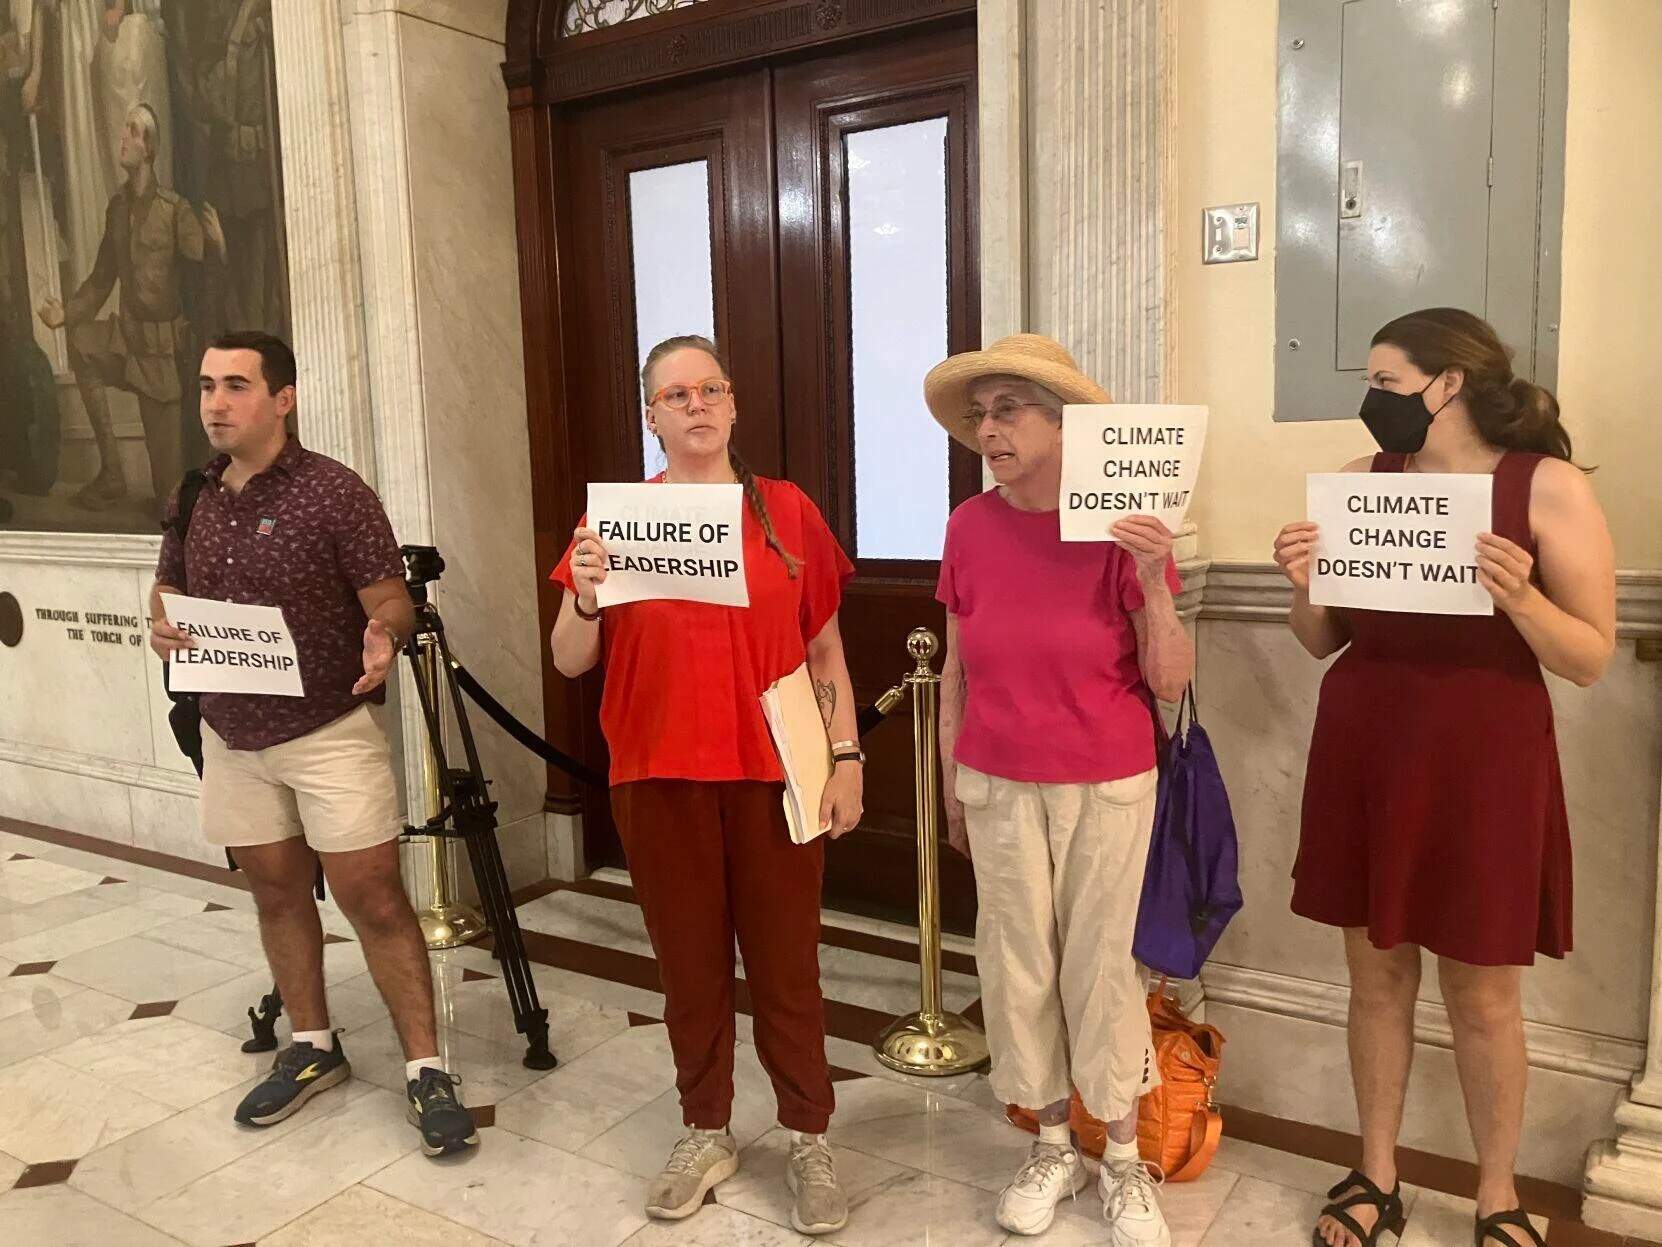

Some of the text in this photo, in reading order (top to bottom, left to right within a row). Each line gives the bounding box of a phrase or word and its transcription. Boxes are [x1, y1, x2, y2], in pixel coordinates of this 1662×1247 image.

[1102, 427, 1185, 445] CLIMATE
[1103, 459, 1181, 478] CHANGE
[1069, 490, 1191, 510] DOESN'T WAIT
[1347, 495, 1449, 516] CLIMATE
[599, 520, 730, 544] FAILURE OF
[1349, 527, 1447, 549] CHANGE
[604, 554, 739, 578] EADERSHIP
[1317, 558, 1479, 584] DOESN'T WAIT
[35, 608, 79, 623] THROUGH
[85, 612, 138, 628] SUFFERING
[66, 628, 143, 647] THE TORCH OF
[176, 621, 283, 644] FAILURE OF
[175, 648, 294, 671] LEADERSHIP
